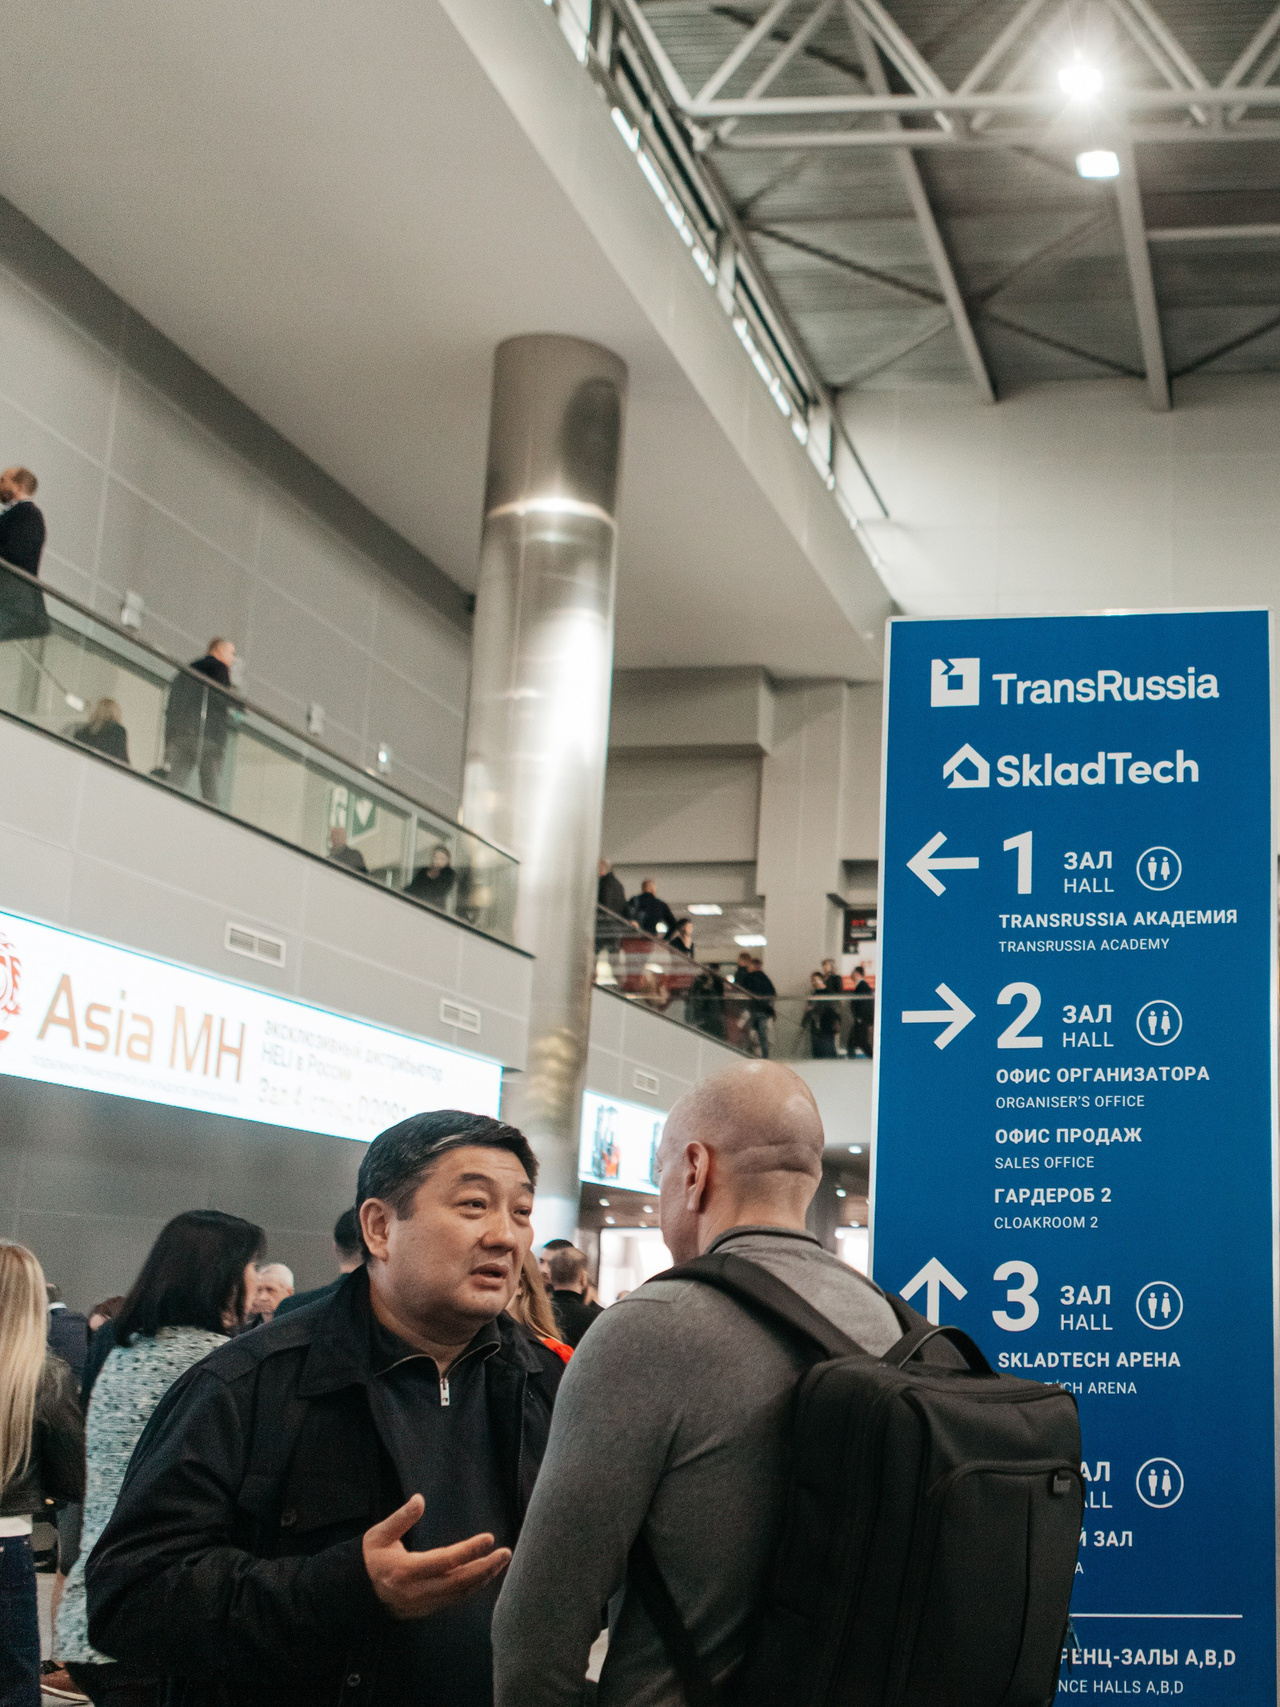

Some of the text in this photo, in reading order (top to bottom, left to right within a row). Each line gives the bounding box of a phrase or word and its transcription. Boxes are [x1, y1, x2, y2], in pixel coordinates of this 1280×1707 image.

[991, 666, 1220, 705] TransRussia
[996, 749, 1199, 788] SkladTech
[1003, 830, 1033, 895] 1
[1063, 850, 1113, 870] ЗАЛ
[1064, 877, 1115, 894] HALL
[998, 909, 1238, 929] TRANSRUSSIA АКАДЕМИЯ
[998, 938, 1170, 953] TRANSRUSSIA ACADEMY
[996, 981, 1043, 1049] 2
[1062, 1004, 1112, 1024] ЗАЛ
[37, 973, 154, 1063] Asia
[169, 1005, 246, 1083] MH
[1062, 1031, 1114, 1048] HALL
[996, 1066, 1210, 1085] ОФИС ОРГАНИЗАТОРА
[1094, 1094, 1145, 1108] OFFICE
[995, 1127, 1142, 1147] ОФИС ПРОДАЖ
[994, 1156, 1095, 1170] SALES OFFICE
[994, 1187, 1112, 1207] ГАРДЕРОБ 2
[993, 1216, 1098, 1230] CLOAKROOM 2
[991, 1260, 1040, 1332] 3
[1060, 1285, 1111, 1306] ЗАЛ
[1060, 1313, 1113, 1331] HALL
[998, 1351, 1181, 1368] SKLADTECH АРЕНА
[1087, 1381, 1137, 1395] ARENA
[1080, 1461, 1111, 1482] АЛ
[1093, 1530, 1133, 1547] ЗАЛ
[1060, 1648, 1237, 1669] РЕНЦ-ЗАЛЫ A,B,D
[1093, 1680, 1141, 1694] HALLS
[1146, 1680, 1184, 1696] A,B,D
